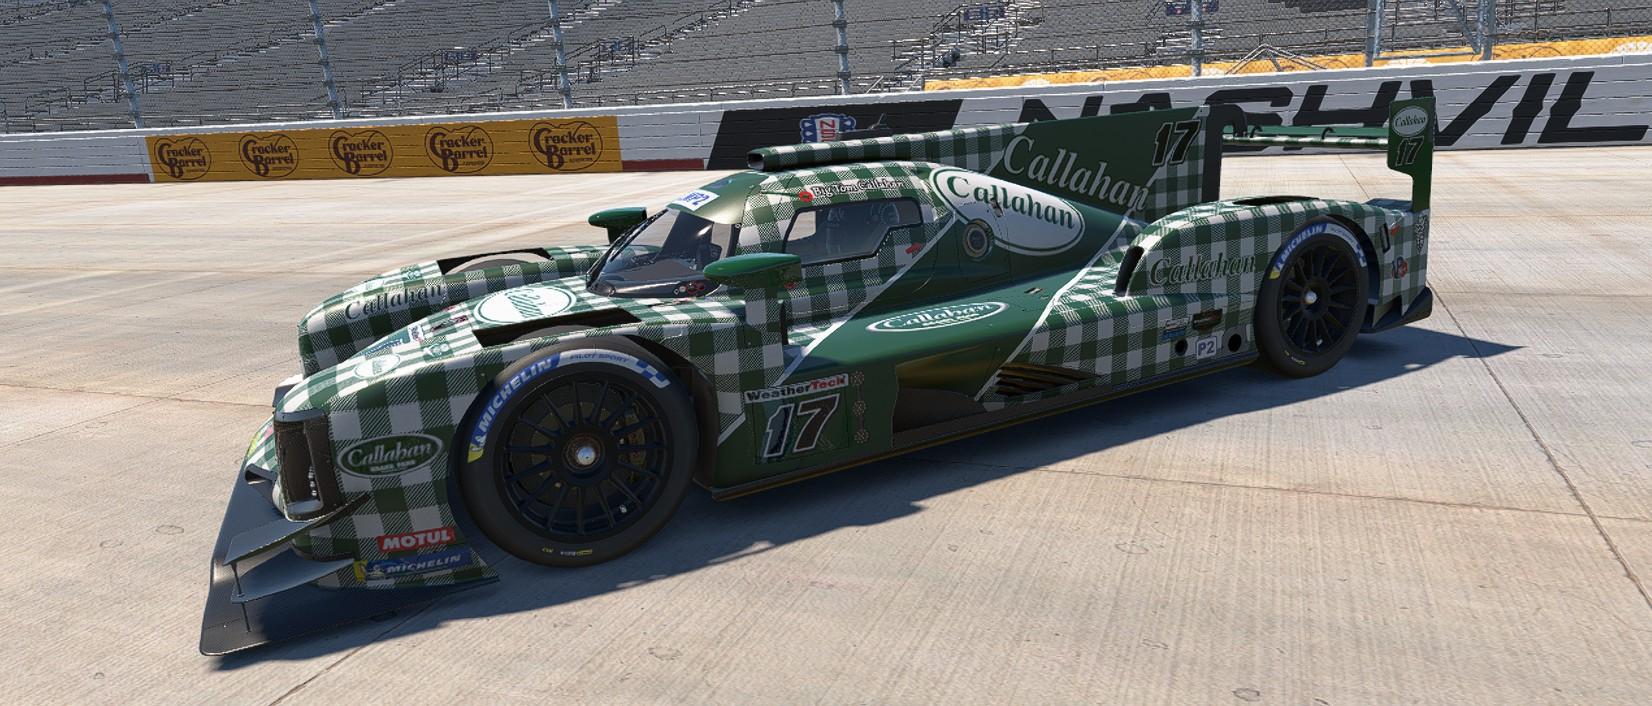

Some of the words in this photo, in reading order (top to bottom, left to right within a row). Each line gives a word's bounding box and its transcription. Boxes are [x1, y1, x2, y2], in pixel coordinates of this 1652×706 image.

[243, 139, 290, 163] Cracker
[333, 136, 384, 161] Cracker
[430, 132, 485, 159] Cracker
[534, 127, 593, 154] Cracker
[1152, 119, 1201, 167] 17
[1396, 135, 1425, 167] 17
[158, 142, 203, 165] Cracker
[254, 153, 294, 176] Barrel
[344, 151, 387, 175] Barrel
[441, 147, 488, 172] Barrel
[546, 142, 596, 170] Barrel
[168, 155, 206, 178] Barrel
[1003, 135, 1150, 211] Callahan
[812, 186, 832, 198] Big
[946, 175, 1075, 230] Callahan
[1282, 224, 1323, 262] MICHELIN
[1150, 252, 1256, 286] Callahan
[344, 284, 441, 320] Callahan
[883, 304, 993, 328] Callahan
[599, 353, 630, 364] SPORT
[1197, 340, 1215, 356] P2
[477, 358, 554, 432] MICHELIN
[763, 393, 840, 458] 17
[347, 441, 432, 467] Callahan
[382, 529, 452, 550] MOTUL
[386, 554, 461, 573] MICHELIN
